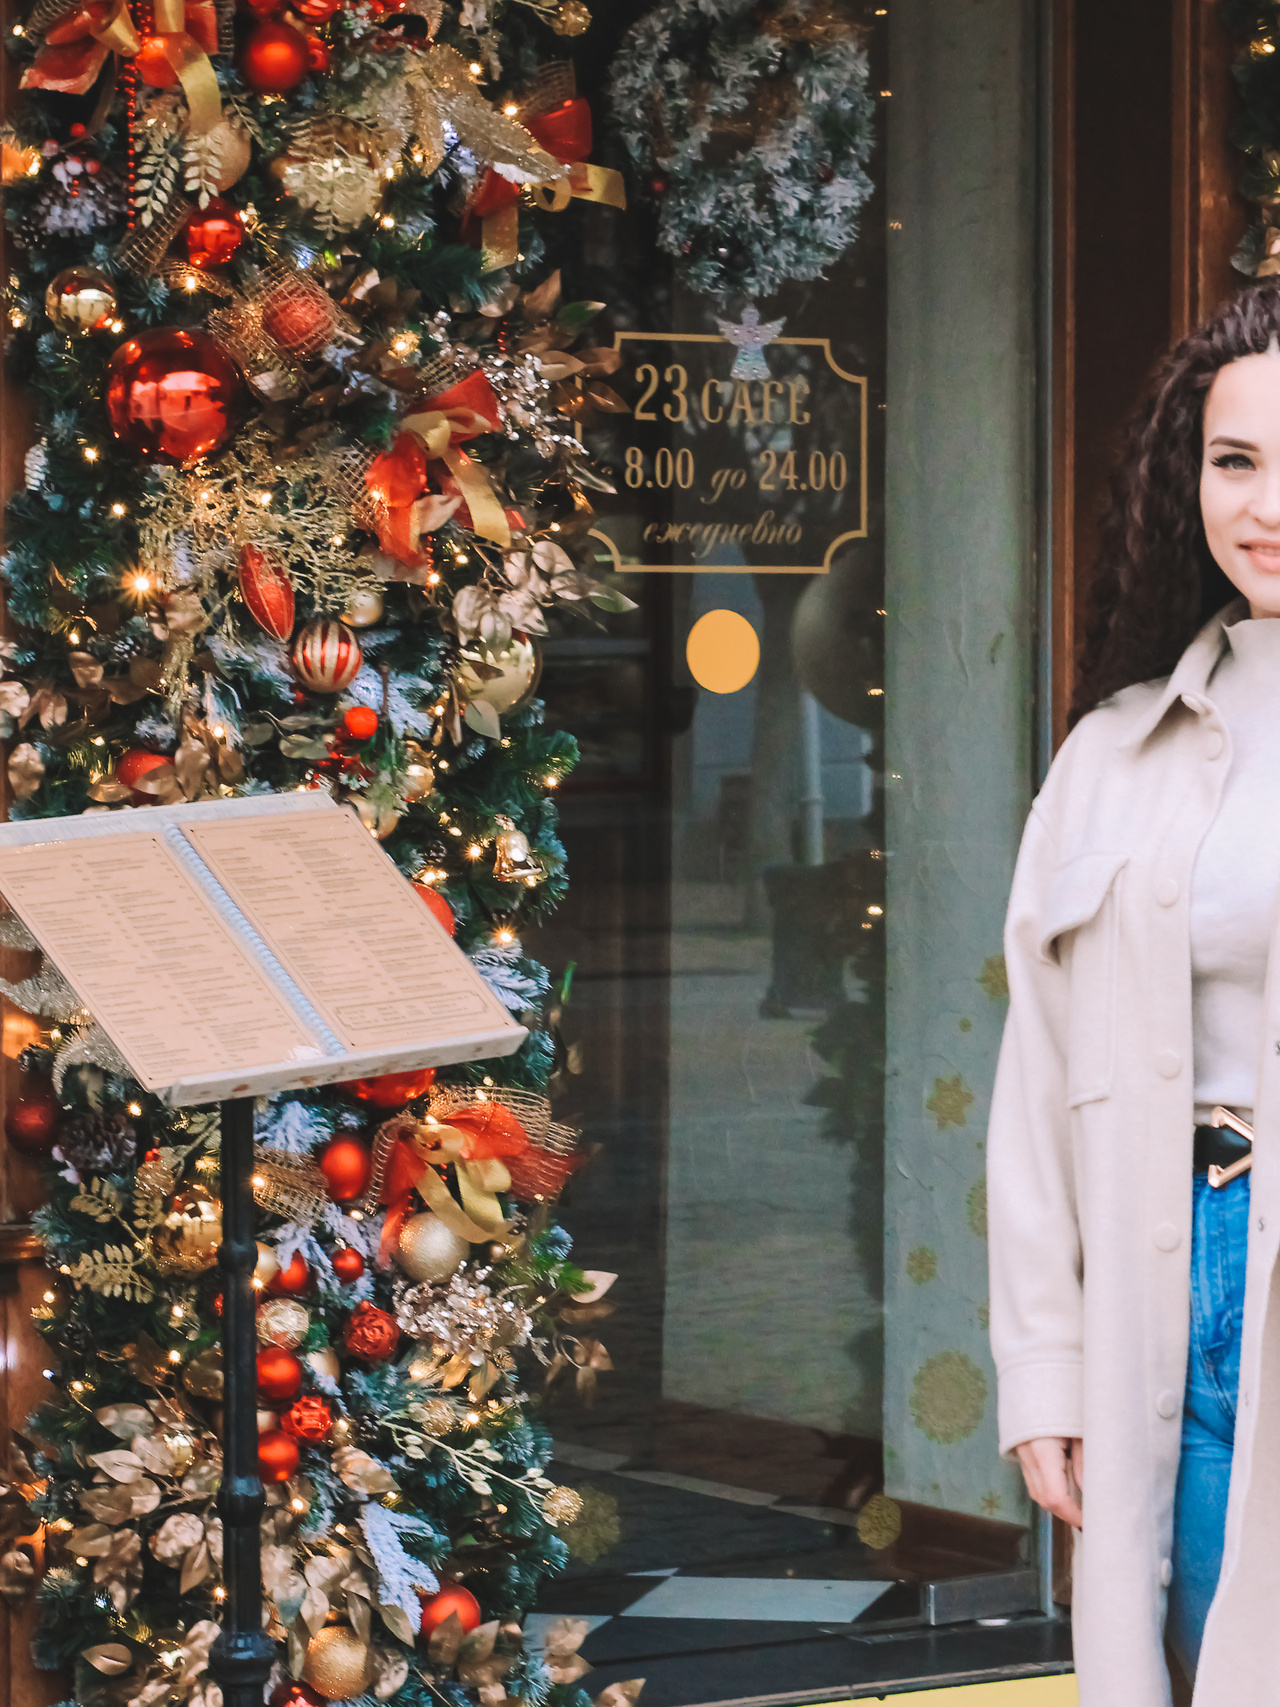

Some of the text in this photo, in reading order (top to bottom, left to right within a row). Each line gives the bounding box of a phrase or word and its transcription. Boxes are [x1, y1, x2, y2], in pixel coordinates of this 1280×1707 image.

[634, 364, 811, 425] 23 CAFE
[624, 446, 695, 489] 8.00
[759, 450, 848, 491] 24.00
[643, 510, 803, 558] ежедневно
